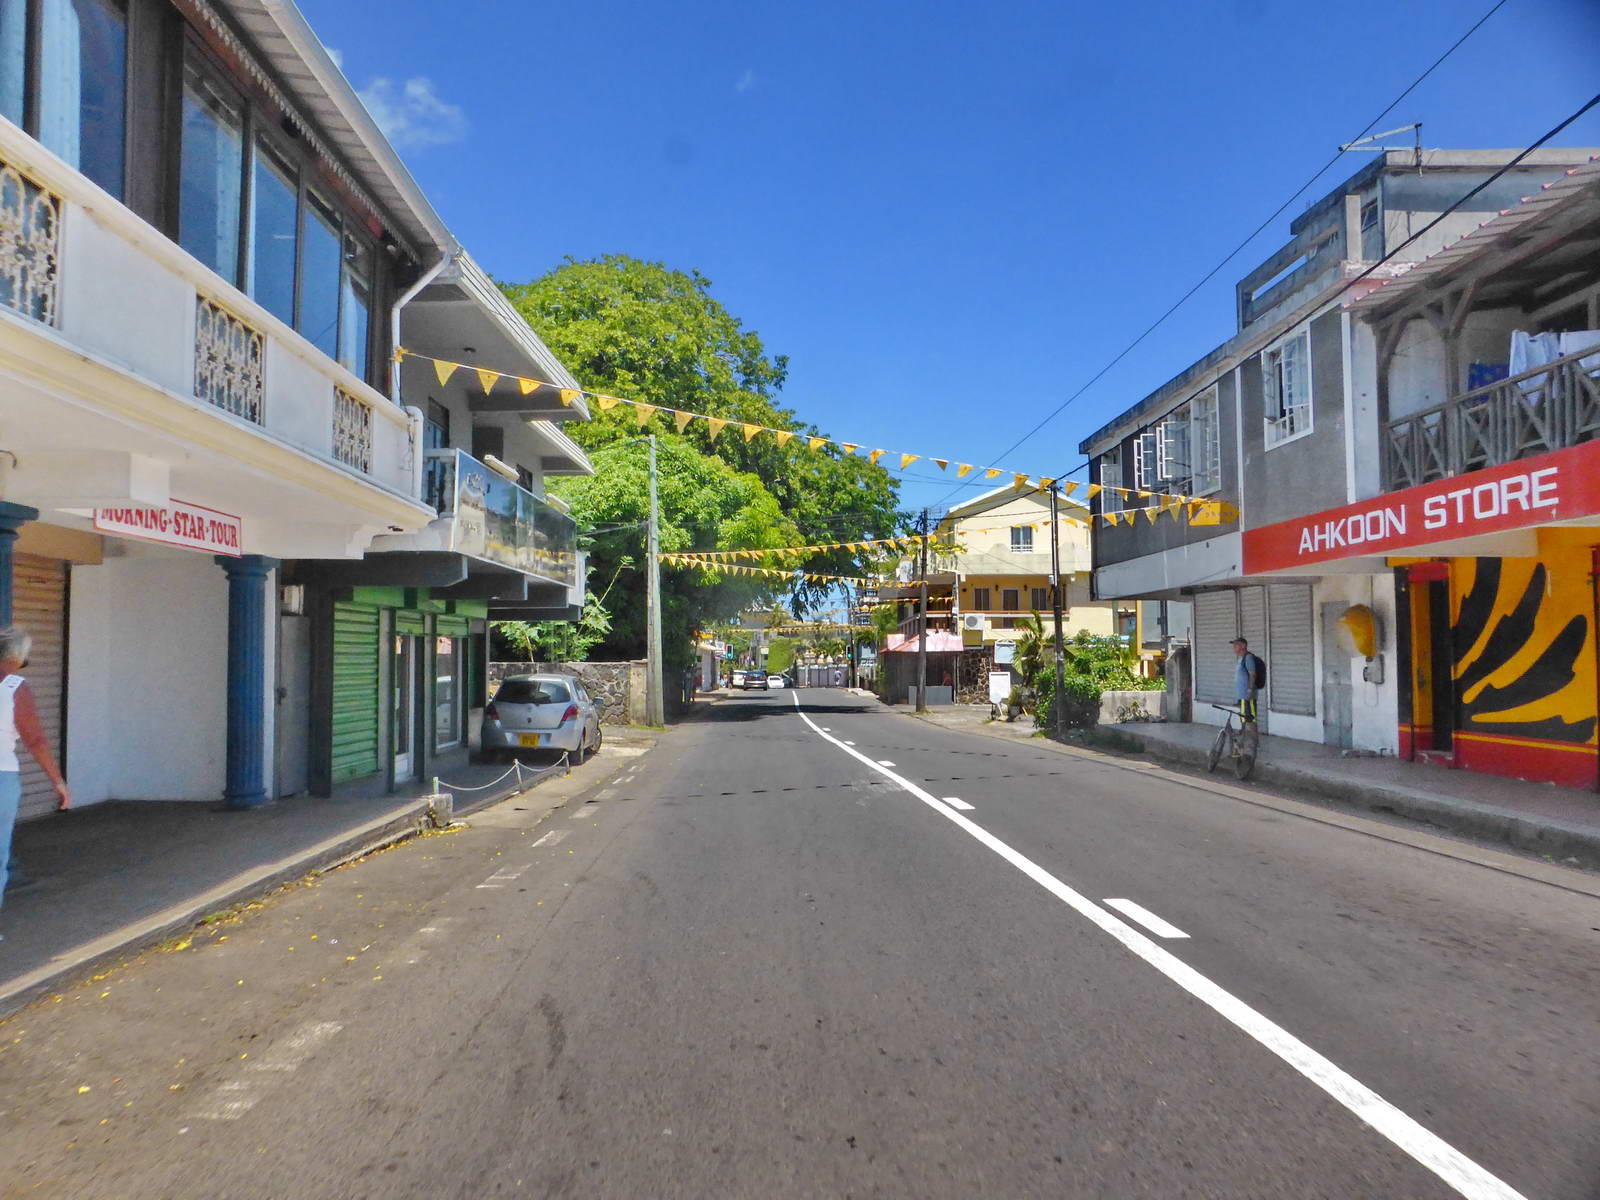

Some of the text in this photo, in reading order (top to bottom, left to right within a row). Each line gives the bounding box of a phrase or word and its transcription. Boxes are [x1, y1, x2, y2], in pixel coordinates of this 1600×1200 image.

[174, 511, 205, 541] STAR
[210, 519, 238, 547] TOUR
[1298, 466, 1559, 554] AHKOON STORE
